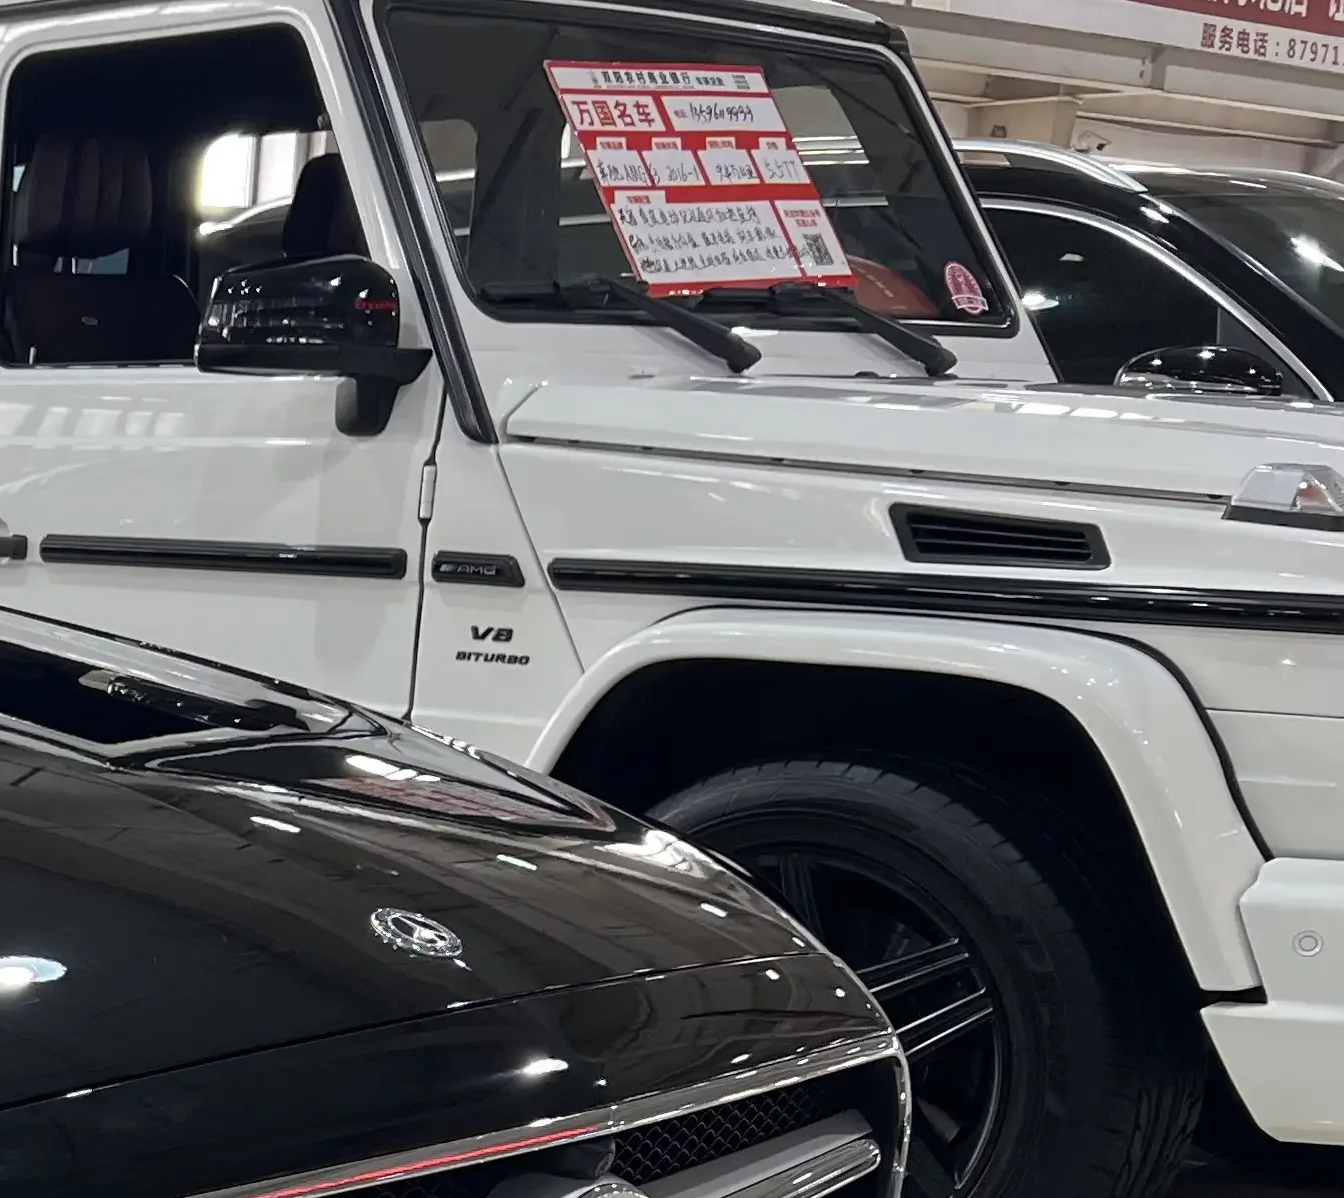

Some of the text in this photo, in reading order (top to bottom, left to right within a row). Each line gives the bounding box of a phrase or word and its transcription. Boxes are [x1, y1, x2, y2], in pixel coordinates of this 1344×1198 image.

[1200, 21, 1344, 67] 服务电话：87971
[572, 100, 656, 127] 万国名车
[470, 625, 514, 642] V8
[455, 651, 530, 666] BITURBO
